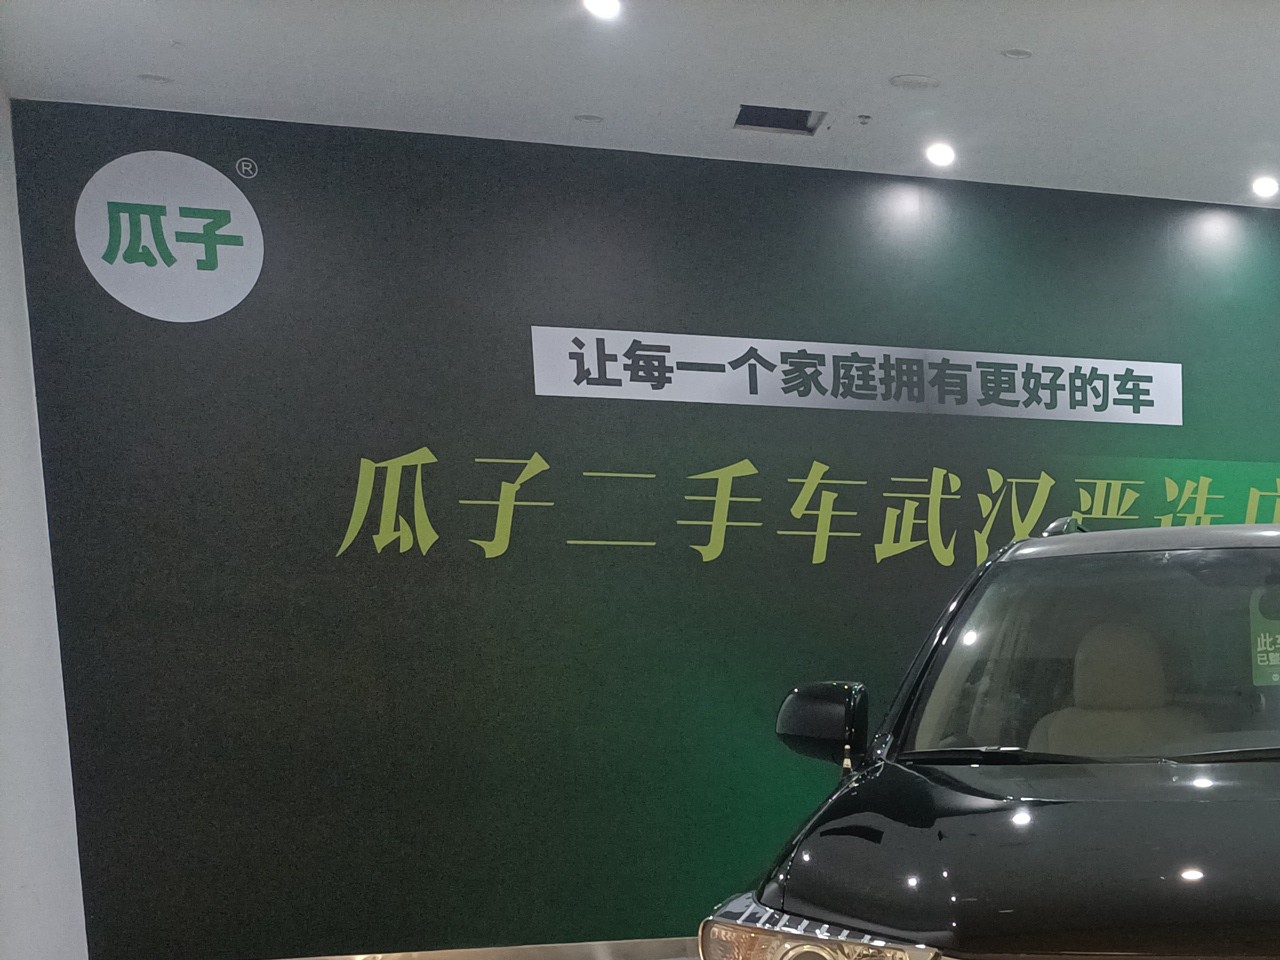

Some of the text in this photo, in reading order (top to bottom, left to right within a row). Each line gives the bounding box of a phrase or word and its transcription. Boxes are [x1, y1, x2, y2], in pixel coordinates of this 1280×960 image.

[101, 200, 244, 272] 瓜子
[568, 337, 1155, 414] 让每一个家庭拥有更好的车
